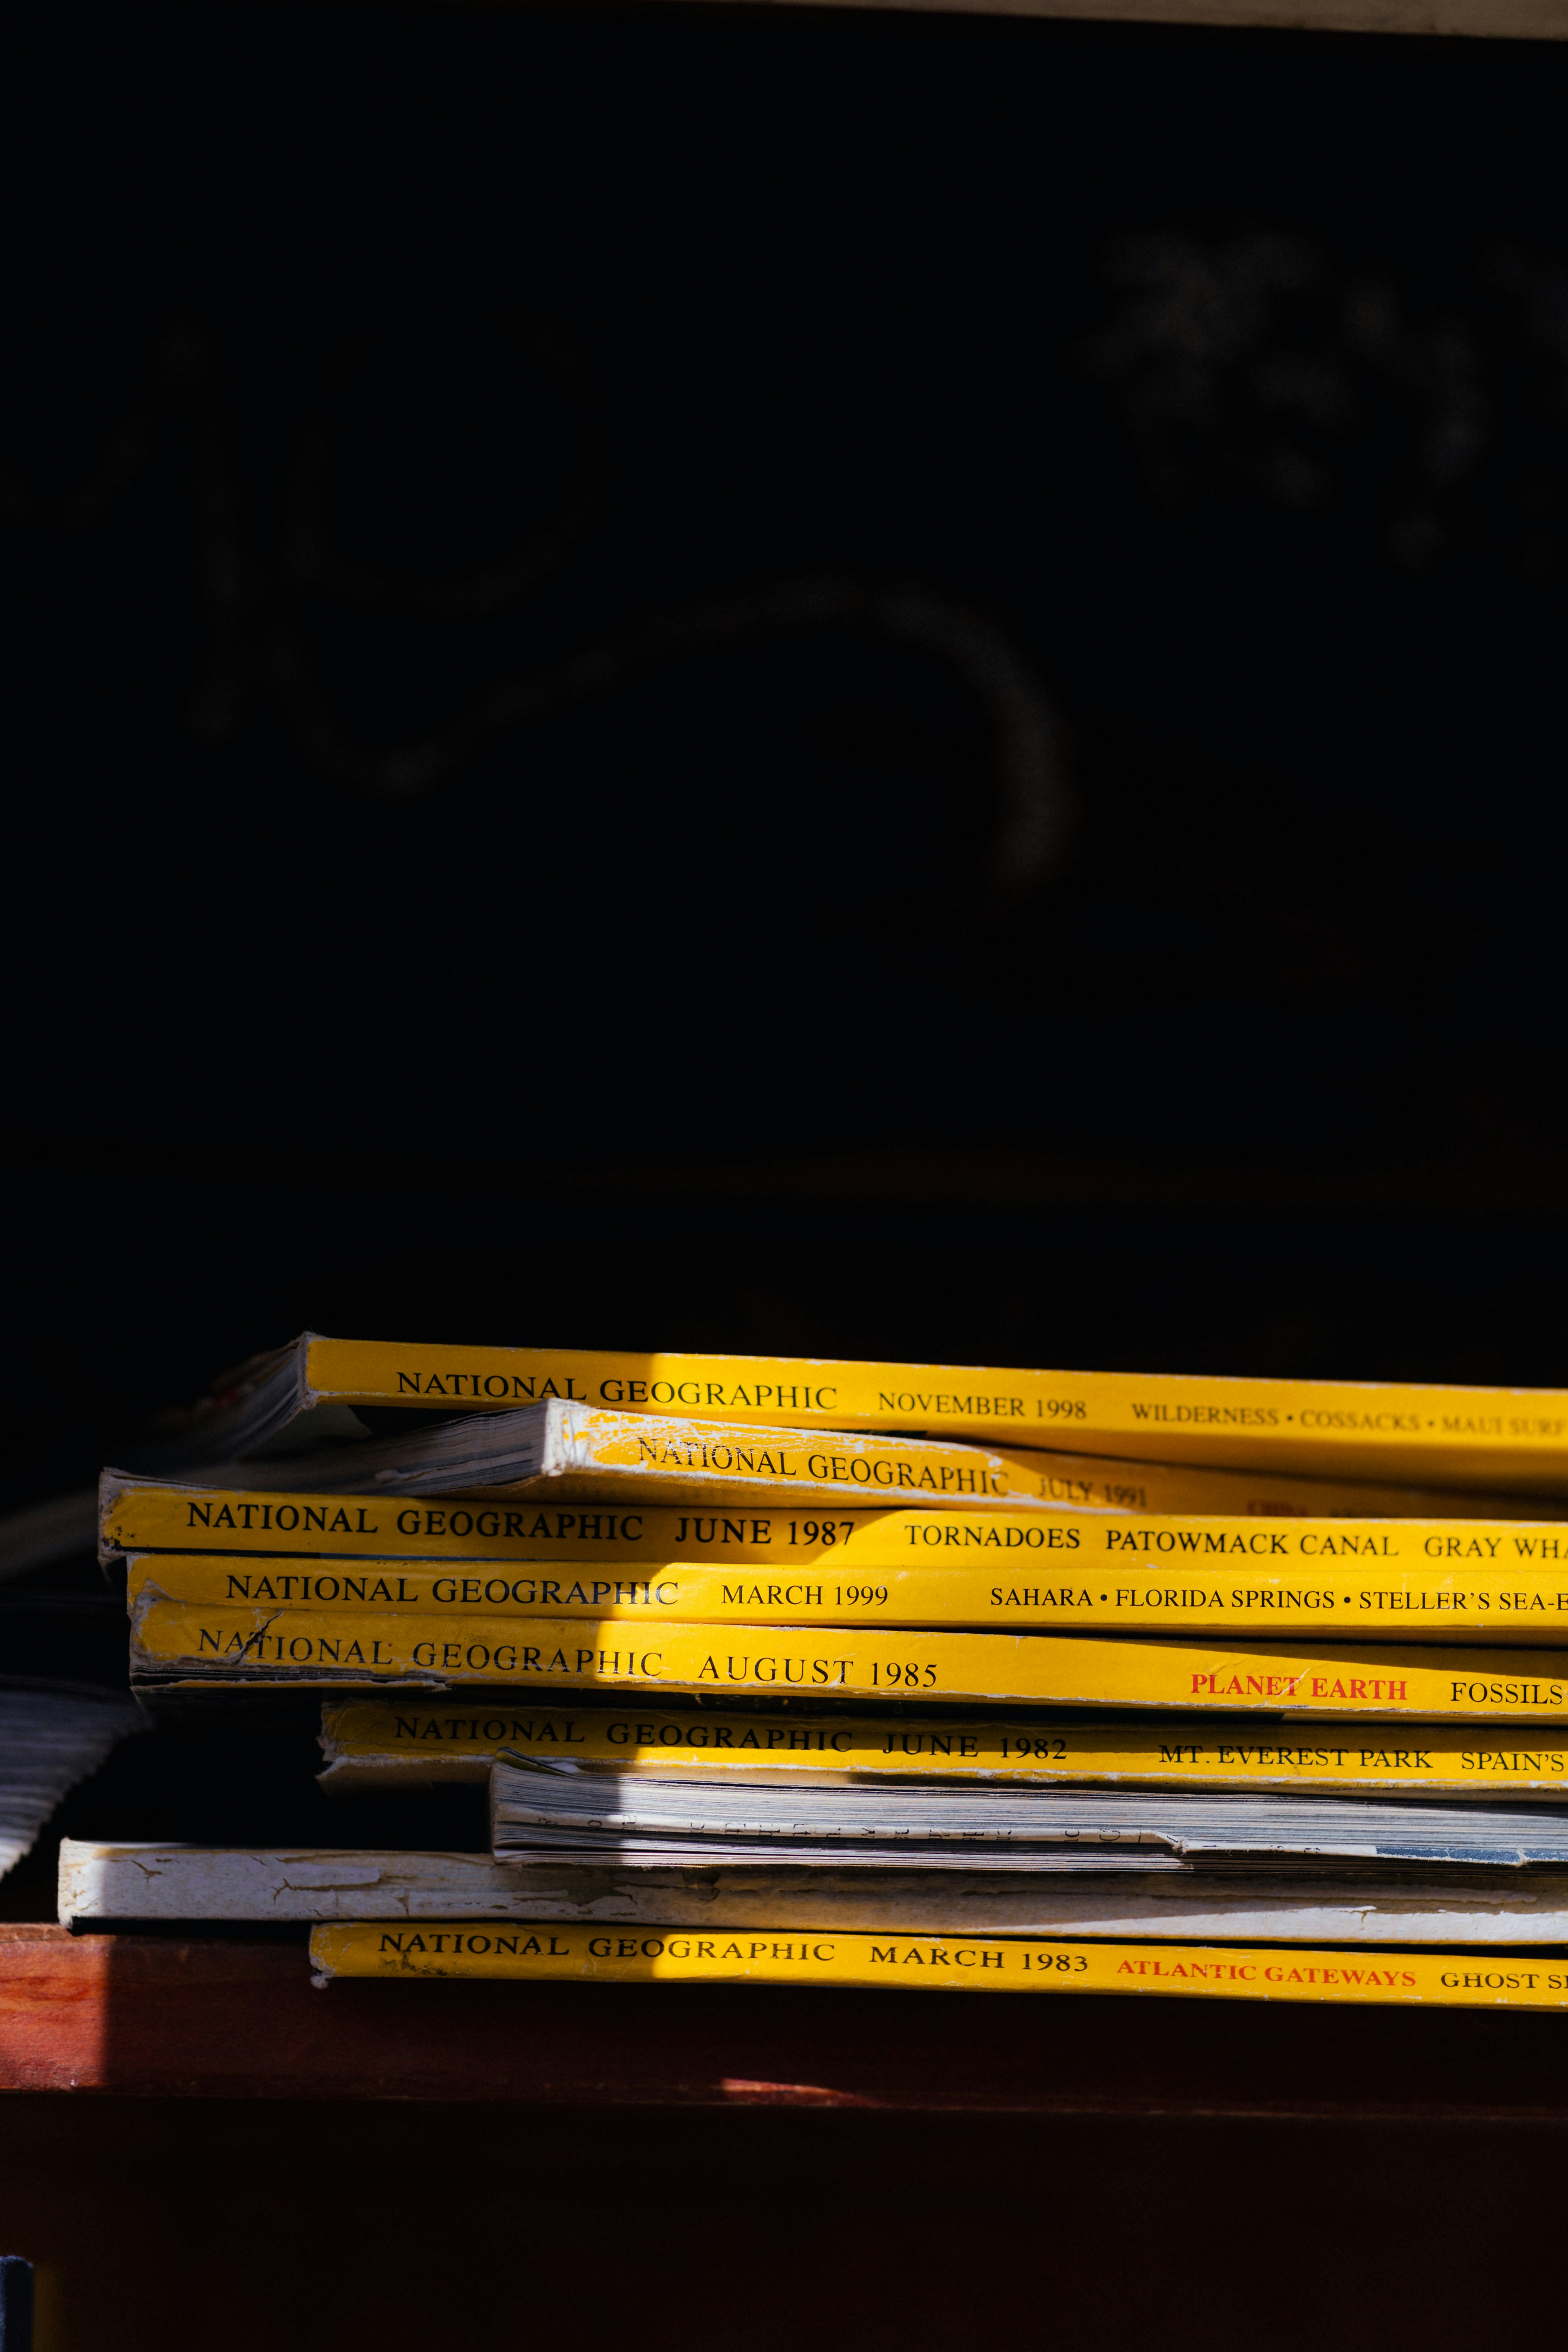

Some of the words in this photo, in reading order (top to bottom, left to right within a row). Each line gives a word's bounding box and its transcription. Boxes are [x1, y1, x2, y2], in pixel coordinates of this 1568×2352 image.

[398, 1372, 587, 1401] NATIONAL
[600, 1378, 837, 1410] GEOGRAPHIC
[879, 1392, 1025, 1416] NOVEMBER
[1036, 1399, 1087, 1419] 1998
[1132, 1403, 1278, 1426] WILDERNESS
[1300, 1411, 1420, 1432] COSSACKS
[637, 1437, 797, 1476] NATIONAL
[809, 1455, 1009, 1497] GEOGRAPHIC
[1039, 1477, 1093, 1501] JULY
[187, 1503, 378, 1533] NATIONAL
[398, 1510, 643, 1540] GEOGRAPHIC
[676, 1517, 772, 1544] JUNE
[788, 1521, 854, 1546] 1987
[905, 1525, 1080, 1548] TORNADOES
[1107, 1530, 1289, 1554] PATOWMACK
[1300, 1535, 1399, 1556] CANAL
[1424, 1536, 1502, 1558] GRAY
[1513, 1538, 1568, 1559] WH
[226, 1575, 419, 1602] NATIONAL
[433, 1579, 679, 1605] GEOGRAPHIC
[722, 1585, 823, 1605] MARCH
[835, 1585, 888, 1606] 1999
[991, 1587, 1093, 1606] SAHARA
[1115, 1589, 1224, 1608] FLORIDA
[1231, 1590, 1335, 1609] SPRINGS
[1360, 1592, 1490, 1610] STELLER'S
[198, 1629, 393, 1665] NATIONAL
[413, 1642, 663, 1677] GEOGRAPHIC
[698, 1655, 854, 1684] AUGUST
[872, 1662, 937, 1687] 1985
[1191, 1674, 1300, 1697] PLANET
[1311, 1678, 1408, 1700] EARTH
[1451, 1682, 1563, 1705] FOSSILS
[395, 1717, 585, 1742] NATIONAL
[607, 1723, 853, 1752] GEOGRAPHIC
[882, 1734, 979, 1757] JUNE
[1001, 1738, 1068, 1760] 1982
[1159, 1745, 1210, 1764] MT.
[1218, 1746, 1349, 1767] EVEREST
[1360, 1749, 1434, 1768] PARK
[1462, 1752, 1564, 1772] SPAIN'S
[378, 1933, 570, 1955] NATIONAL
[589, 1938, 836, 1962] GEOGRAPHIC
[869, 1946, 1005, 1969] MARCH
[1022, 1953, 1088, 1972] 1983
[1118, 1960, 1257, 1981] ATLANTIC
[1265, 1966, 1417, 1987] GATEWAYS
[1441, 1972, 1540, 1988] GHOST
[1548, 1974, 1568, 1989] S
